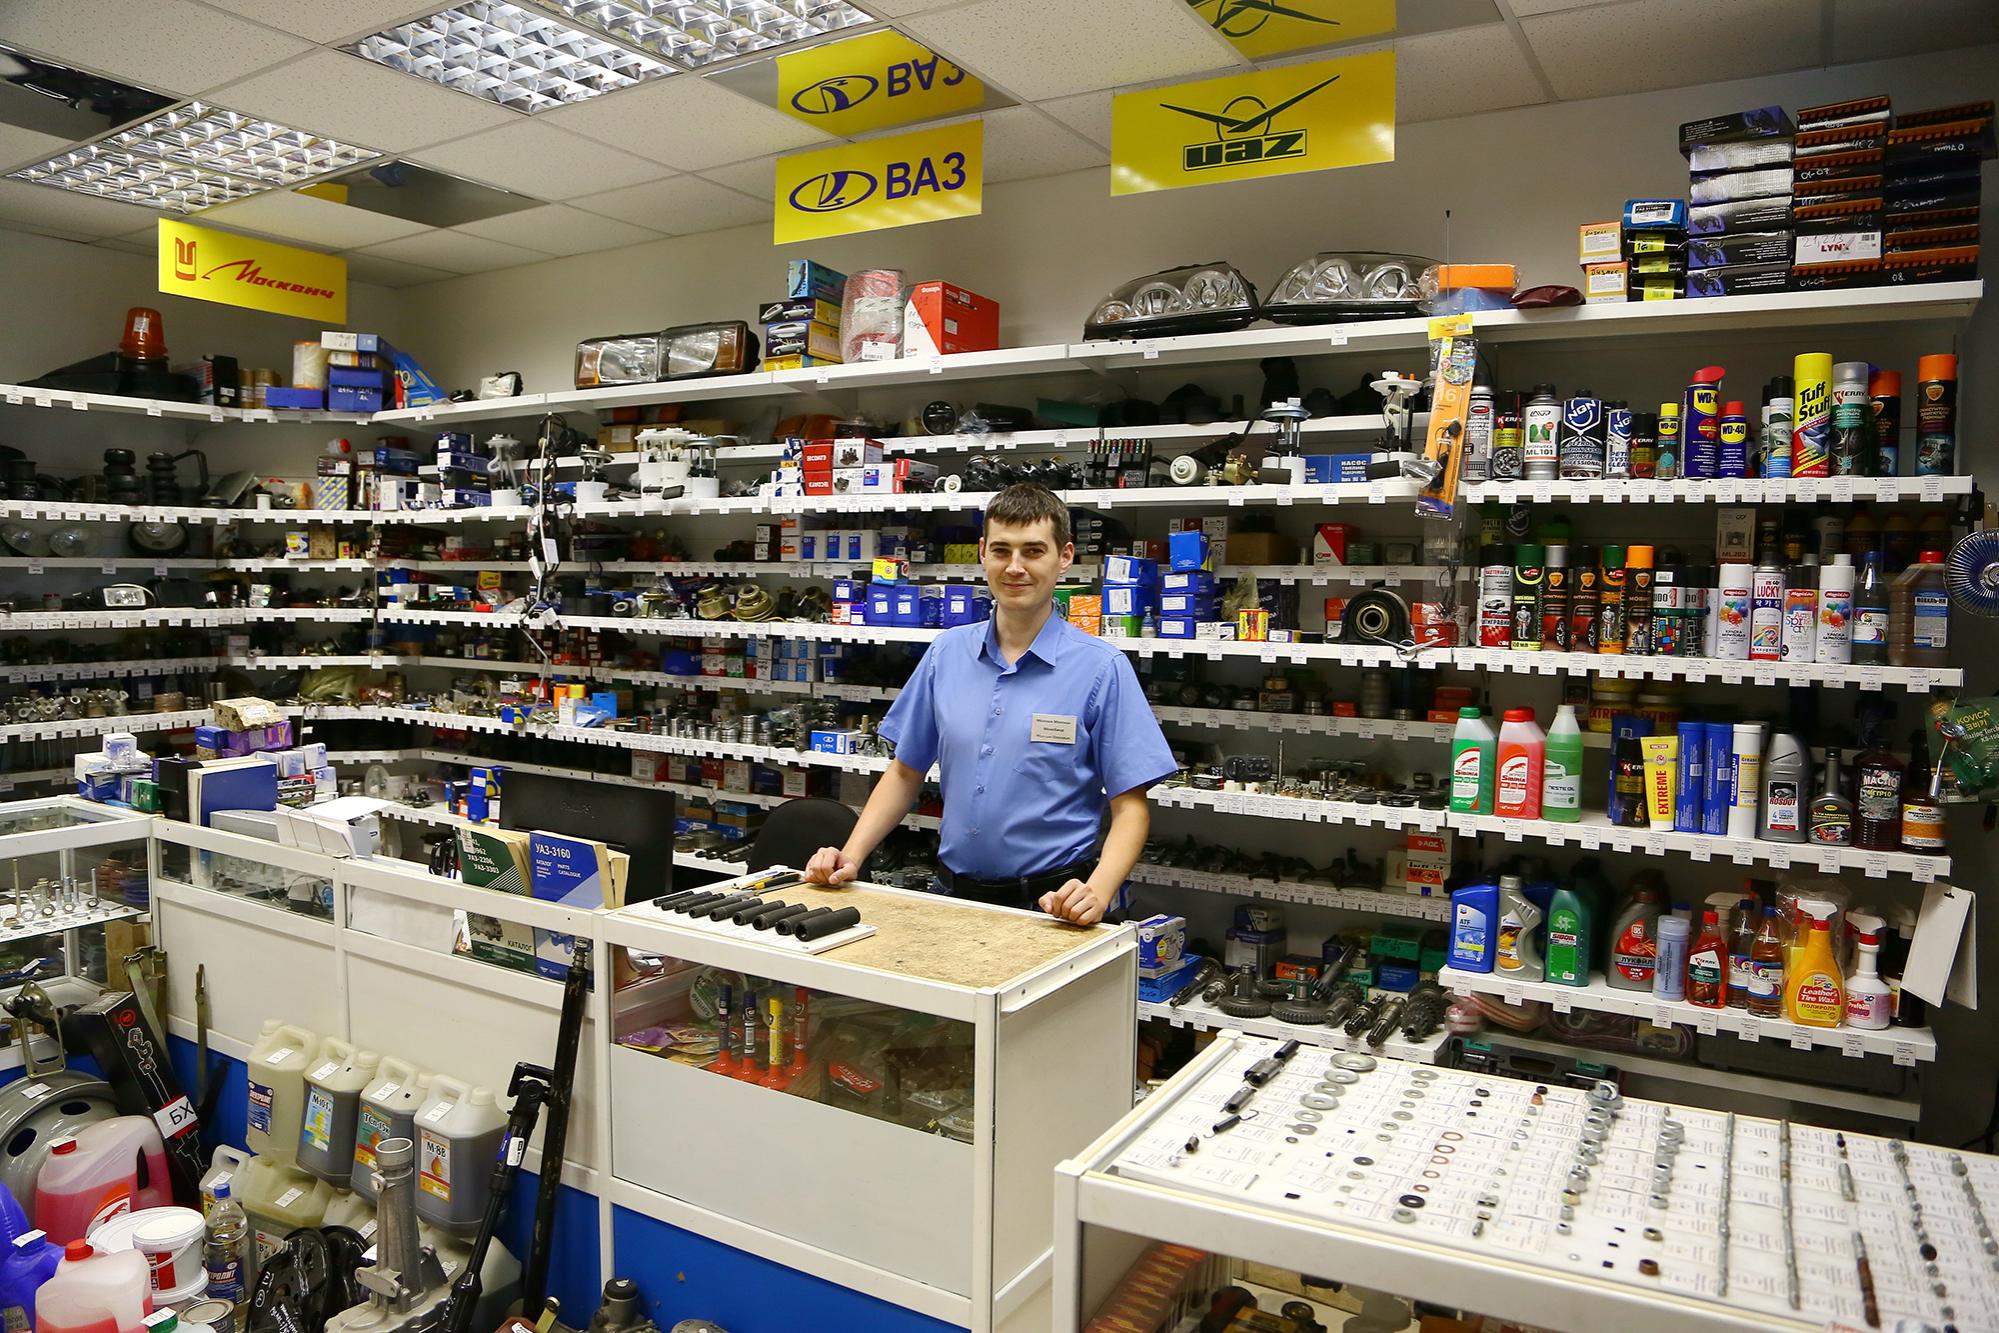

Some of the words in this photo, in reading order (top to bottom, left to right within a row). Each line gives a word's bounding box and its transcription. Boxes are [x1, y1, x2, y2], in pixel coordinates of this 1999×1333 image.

[886, 151, 966, 201] ВАЗ
[201, 259, 335, 299] Москвич
[1697, 392, 1718, 404] WD-4
[1799, 381, 1826, 405] Tuff
[1567, 399, 1597, 421] NGN
[1798, 394, 1831, 423] Stuff
[1613, 414, 1632, 431] NG
[1660, 422, 1677, 430] WD-40
[1720, 426, 1745, 435] WD-40
[1756, 586, 1780, 598] LUCKY
[1956, 708, 1991, 725] KOVICA
[1656, 769, 1670, 815] EXTREME
[535, 842, 571, 859] УАЗ-3160
[507, 939, 532, 952] КАТАЛОГ
[1801, 994, 1816, 1002] Tire
[1818, 996, 1835, 1004] Wax
[1801, 1003, 1837, 1011] ПОЛИРОЛЬ
[168, 1101, 194, 1126] БХ
